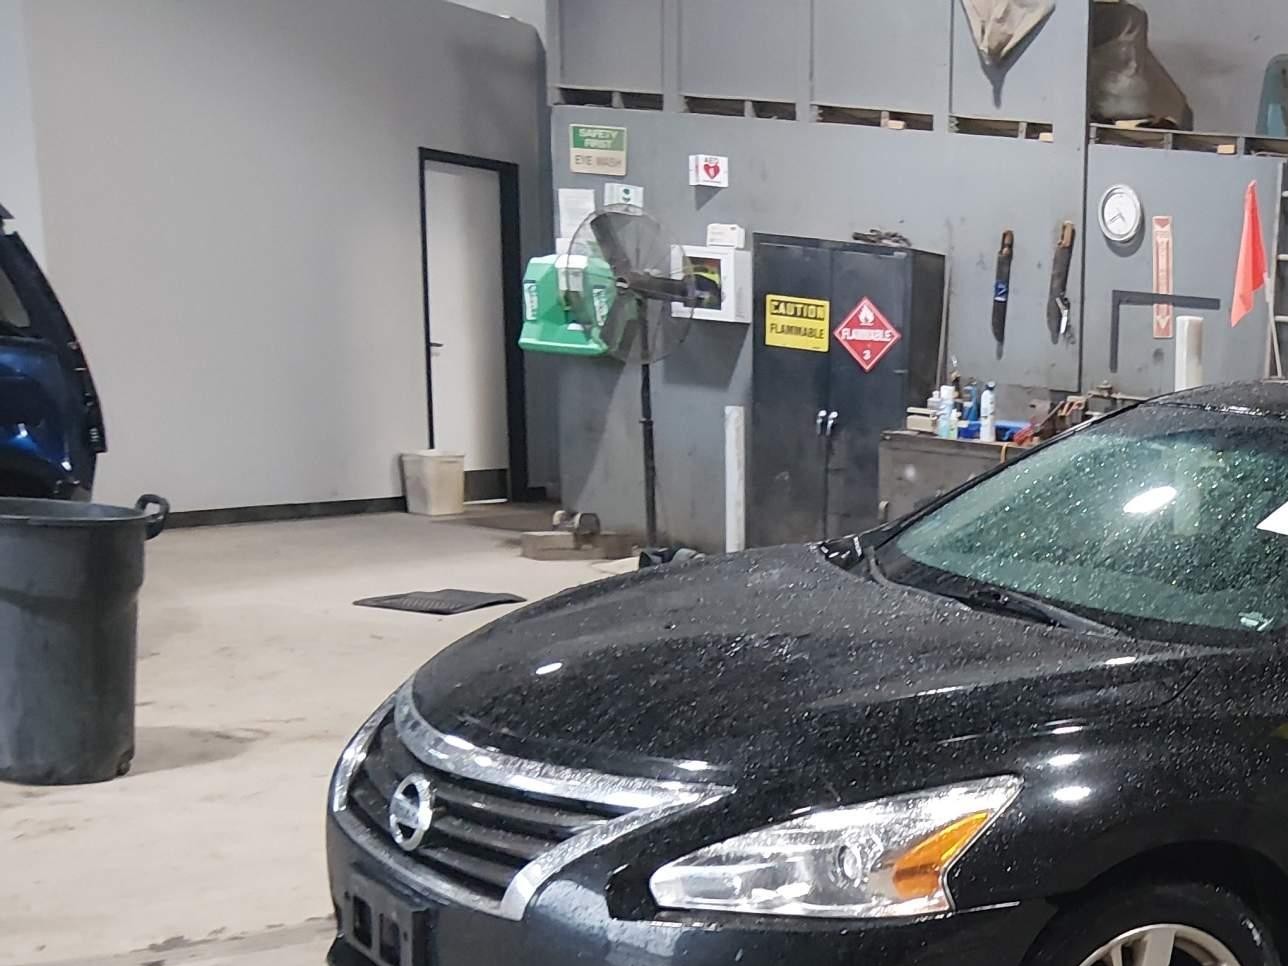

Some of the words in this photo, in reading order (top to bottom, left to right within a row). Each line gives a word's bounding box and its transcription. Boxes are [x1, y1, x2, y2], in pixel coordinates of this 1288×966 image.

[579, 128, 619, 139] SAFETY
[584, 139, 612, 149] FIRST
[575, 154, 592, 166] EYE
[771, 301, 825, 320] CAUTION
[770, 322, 825, 340] FLAMMABLE
